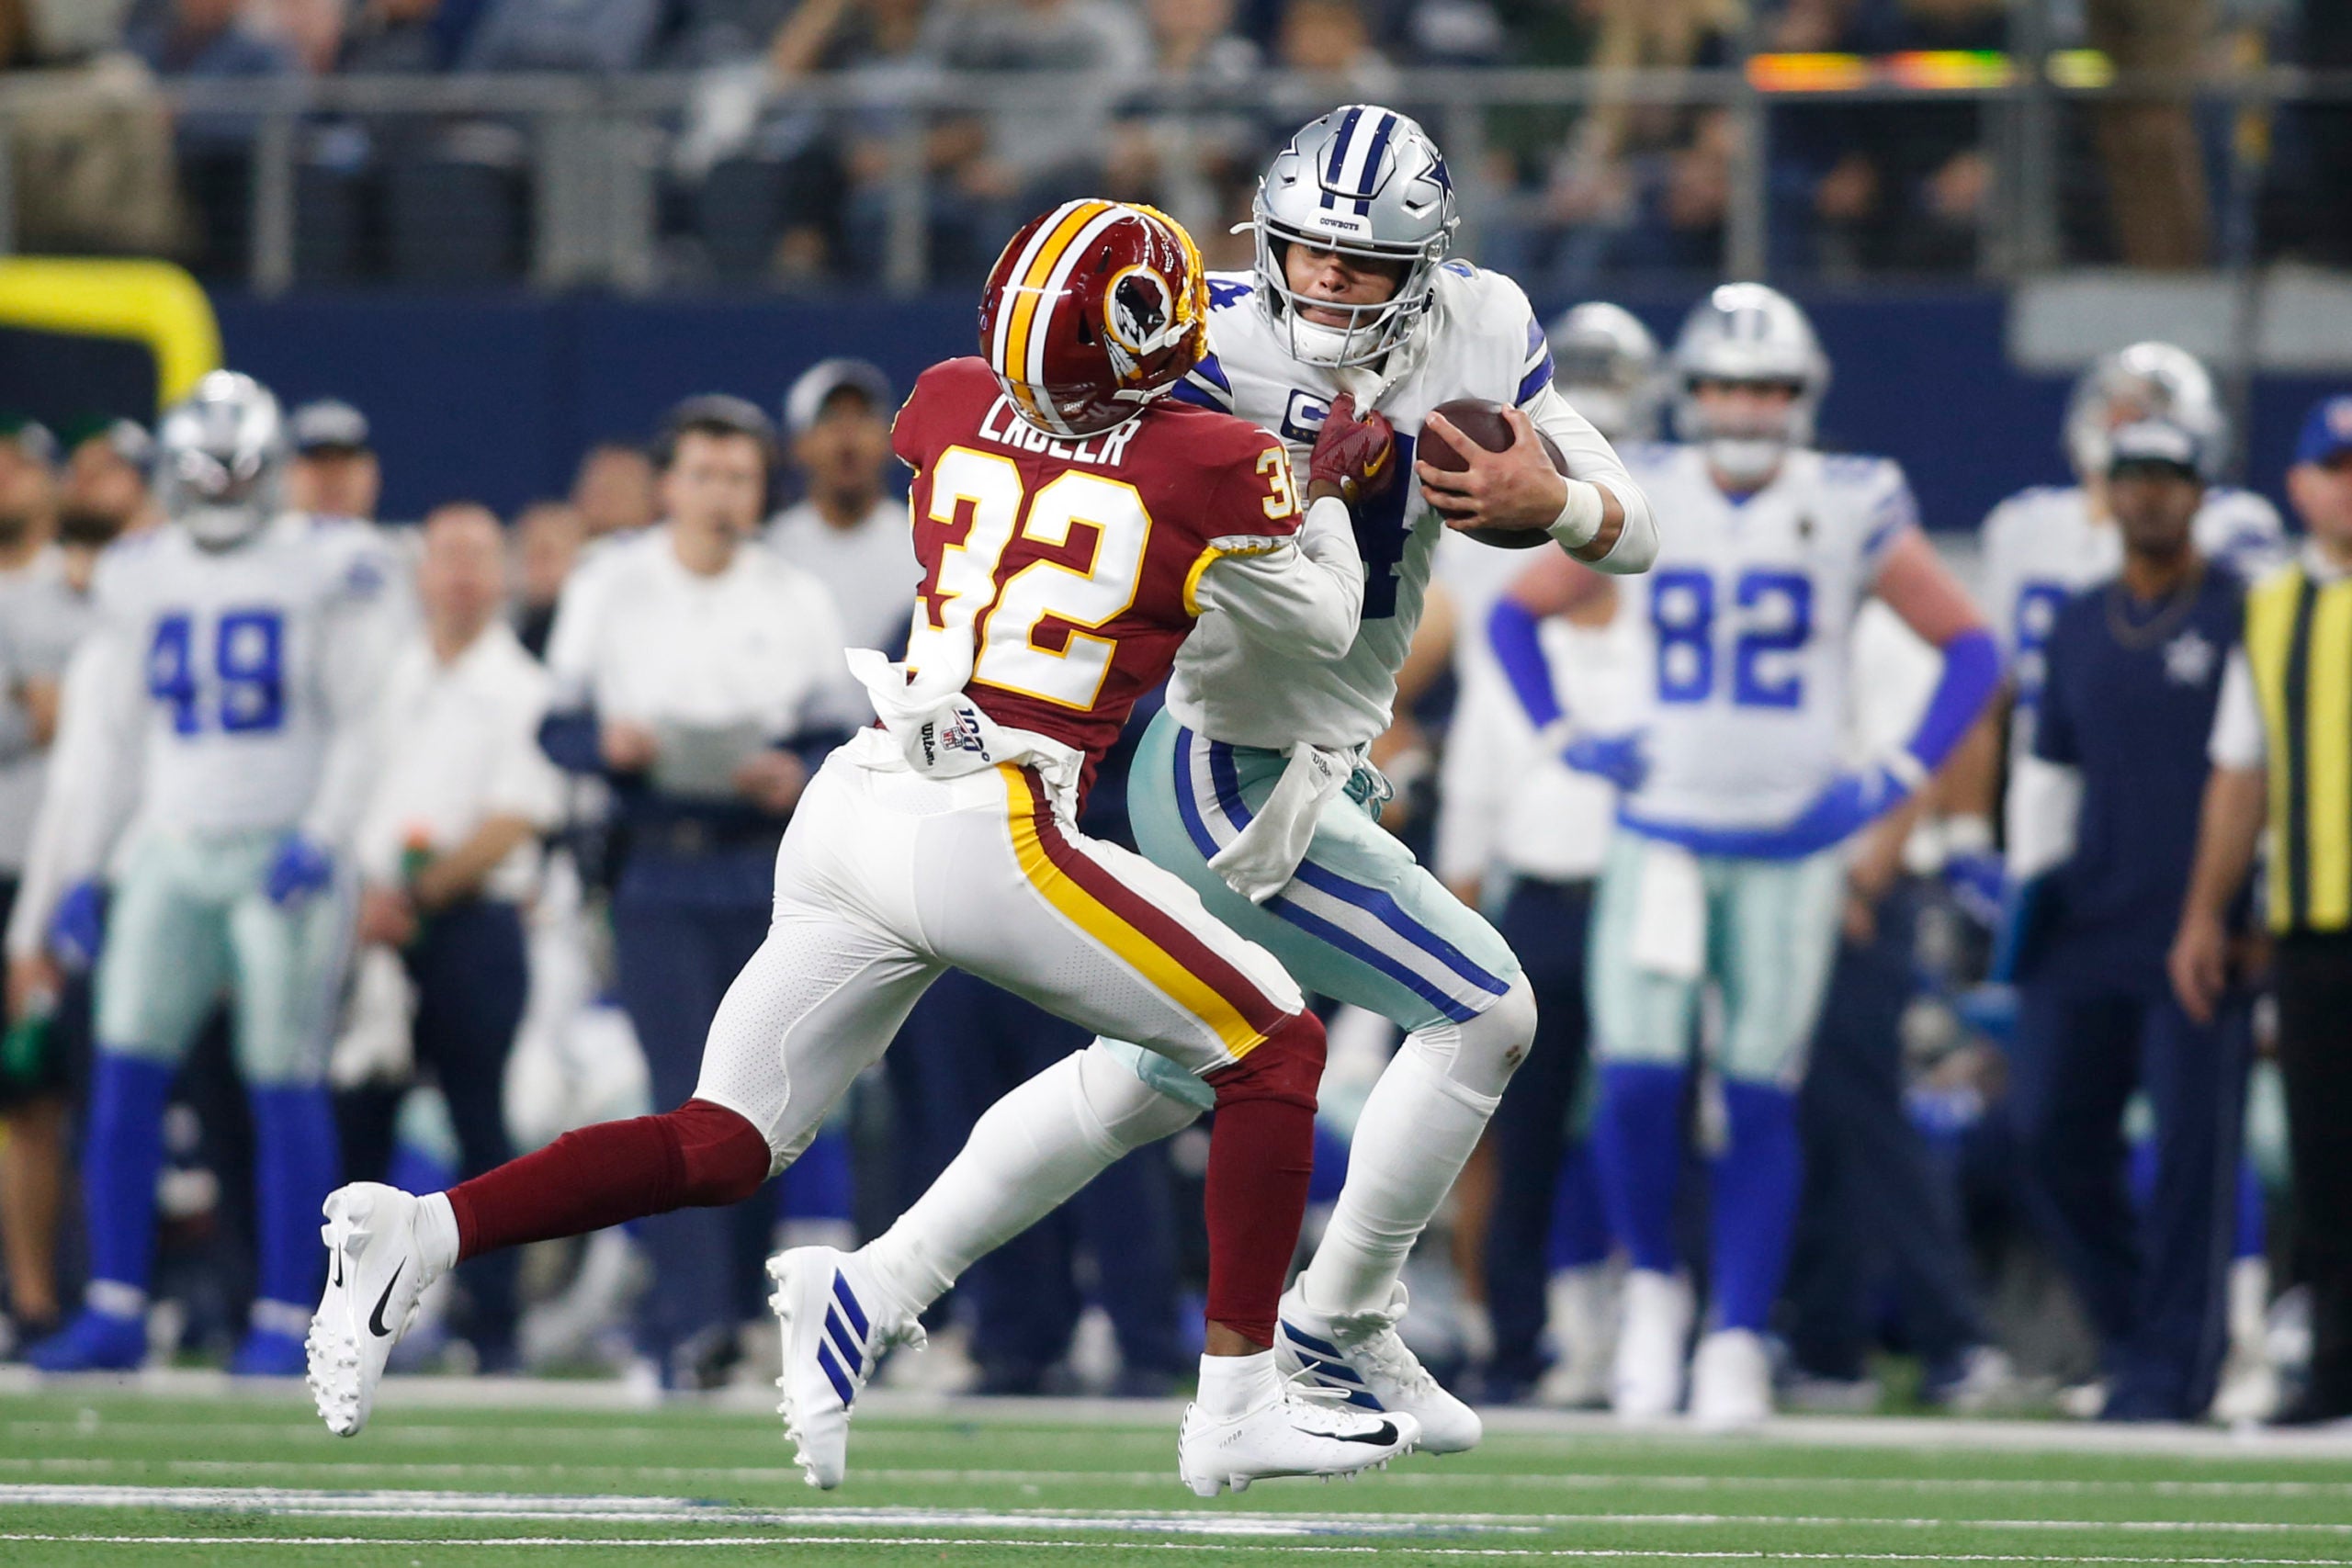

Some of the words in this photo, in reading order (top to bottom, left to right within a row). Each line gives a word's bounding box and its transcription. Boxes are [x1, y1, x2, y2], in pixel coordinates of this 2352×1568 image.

[1319, 217, 1360, 231] COWBOYS
[1288, 393, 1332, 431] C
[1255, 446, 1303, 520] 3
[906, 445, 1152, 711] 32
[1650, 570, 1813, 711] 82
[922, 721, 935, 766] Wilson
[1218, 1429, 1243, 1450] VAPOR
